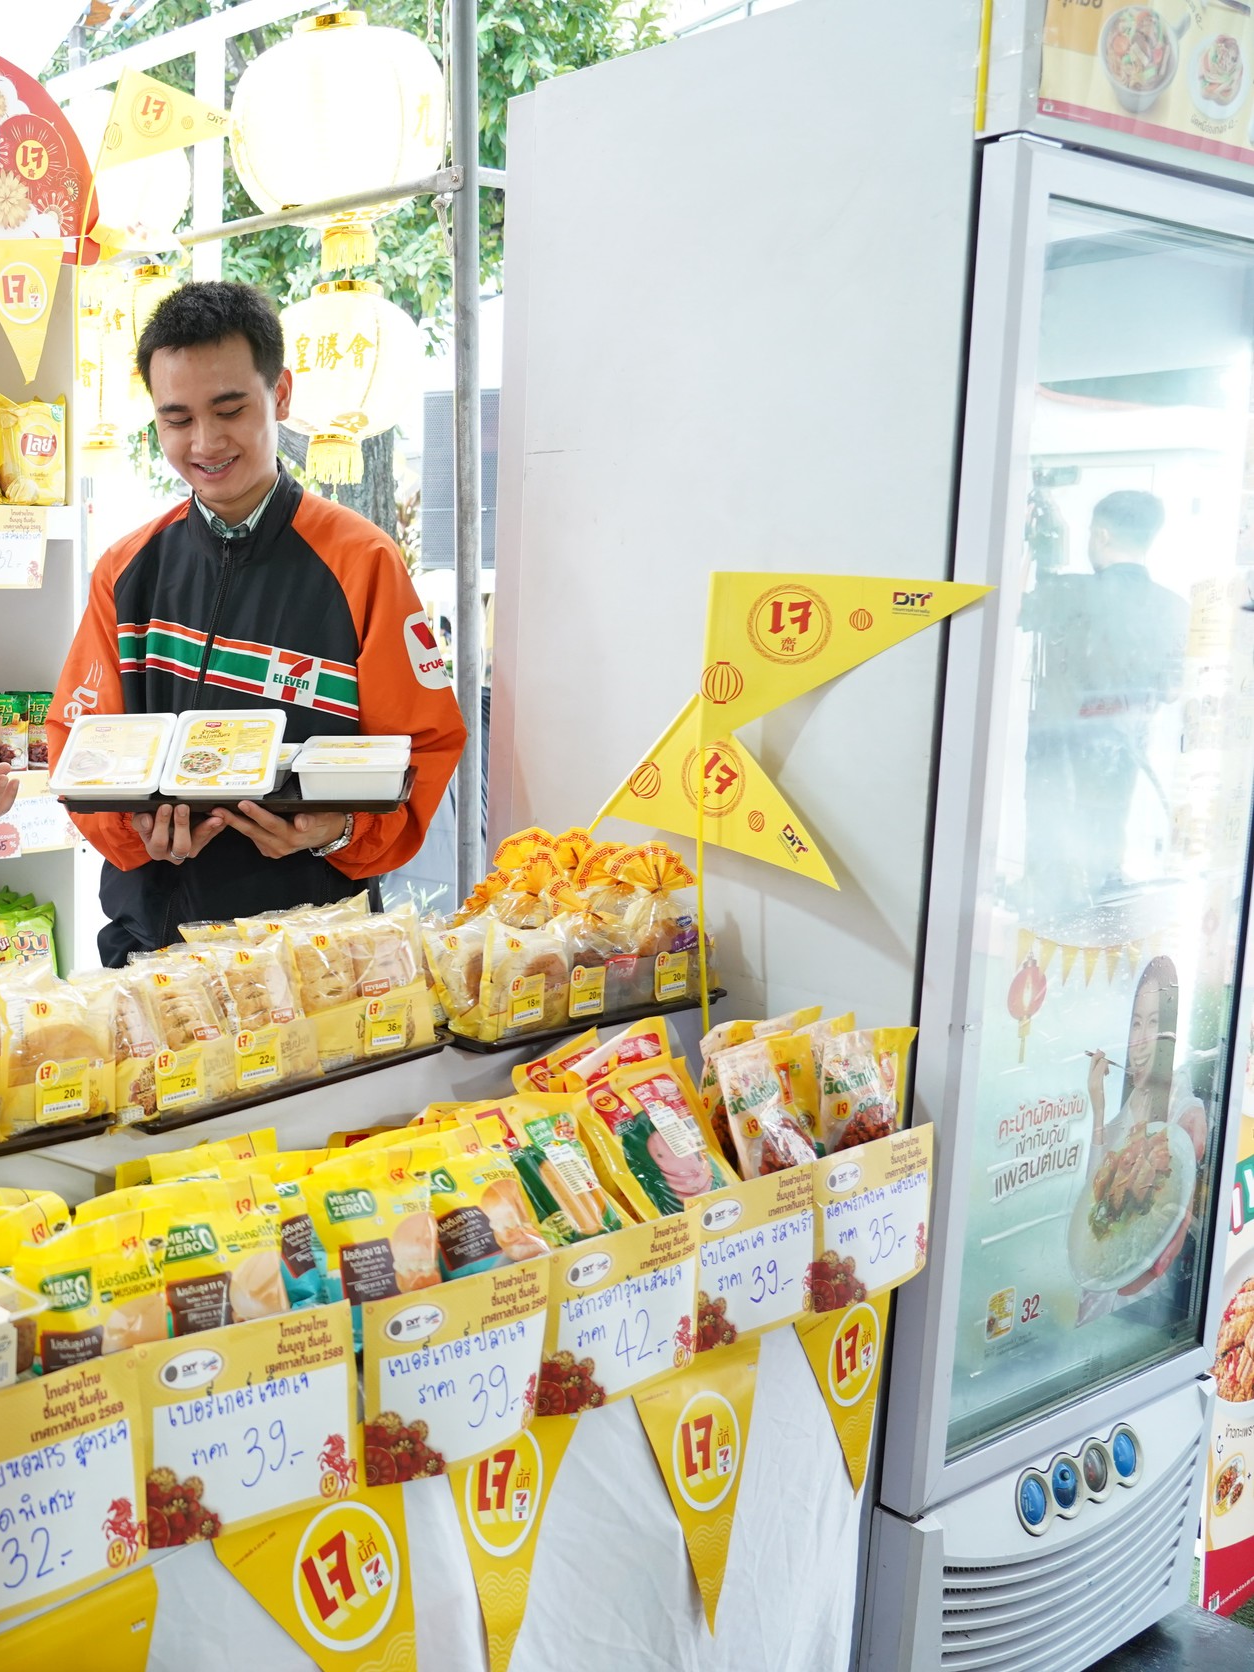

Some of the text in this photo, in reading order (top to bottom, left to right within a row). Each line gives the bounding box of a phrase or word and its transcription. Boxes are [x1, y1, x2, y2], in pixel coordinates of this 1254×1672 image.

[767, 599, 813, 635] เจ
[418, 658, 444, 673] true
[273, 673, 310, 691] ELEVEN
[315, 936, 326, 947] เจ
[35, 1003, 48, 1015] เจ
[596, 1095, 612, 1107] CP
[836, 1103, 848, 1115] เจ
[746, 1119, 758, 1134] เจ
[998, 1095, 1085, 1140] คะน้าผัดเข้มข้น
[1015, 1123, 1066, 1157] เข้ากันกับ
[995, 1144, 1079, 1198] แพลนต์เบส
[328, 1191, 357, 1206] MEAT
[332, 1202, 363, 1217] ZERO
[166, 1230, 197, 1247] MEAT
[839, 1227, 858, 1245] ราคา
[167, 1243, 201, 1258] ZERO
[43, 1279, 74, 1294] MEAT
[718, 1273, 742, 1292] ราคา
[576, 1326, 607, 1348] ราคา
[418, 1378, 456, 1405] ราคา
[192, 1441, 229, 1466] ราคา
[681, 1413, 714, 1478] เจ
[300, 1529, 357, 1622] เจ
